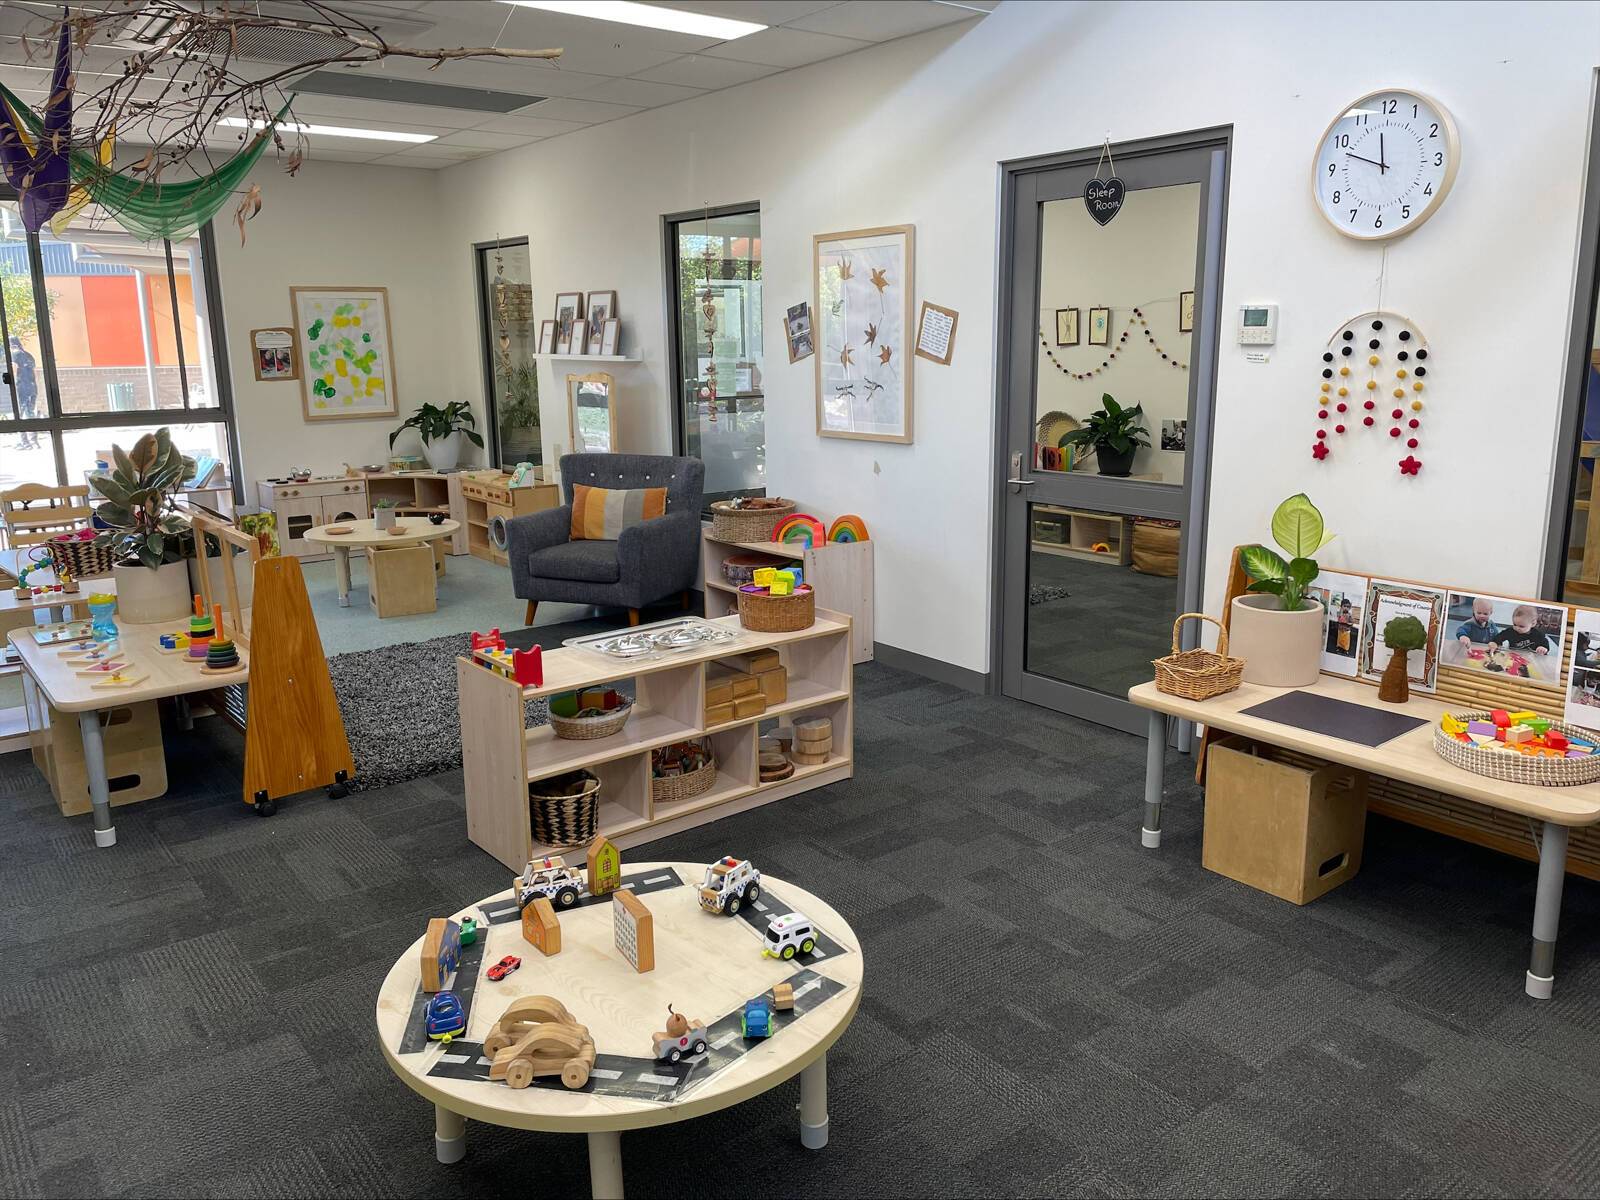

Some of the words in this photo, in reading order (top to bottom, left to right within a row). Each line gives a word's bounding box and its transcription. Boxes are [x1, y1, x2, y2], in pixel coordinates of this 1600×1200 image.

[1382, 99, 1397, 114] 12
[1412, 104, 1418, 118] 1
[1356, 113, 1367, 126] 11
[1429, 123, 1438, 138] 2
[1335, 134, 1349, 148] 10
[1434, 152, 1443, 166] 3
[1328, 163, 1336, 177] 9
[1423, 182, 1432, 196] 4
[1332, 190, 1341, 204] 8
[1350, 209, 1358, 223] 7
[1402, 205, 1410, 219] 5
[1374, 214, 1383, 228] 6
